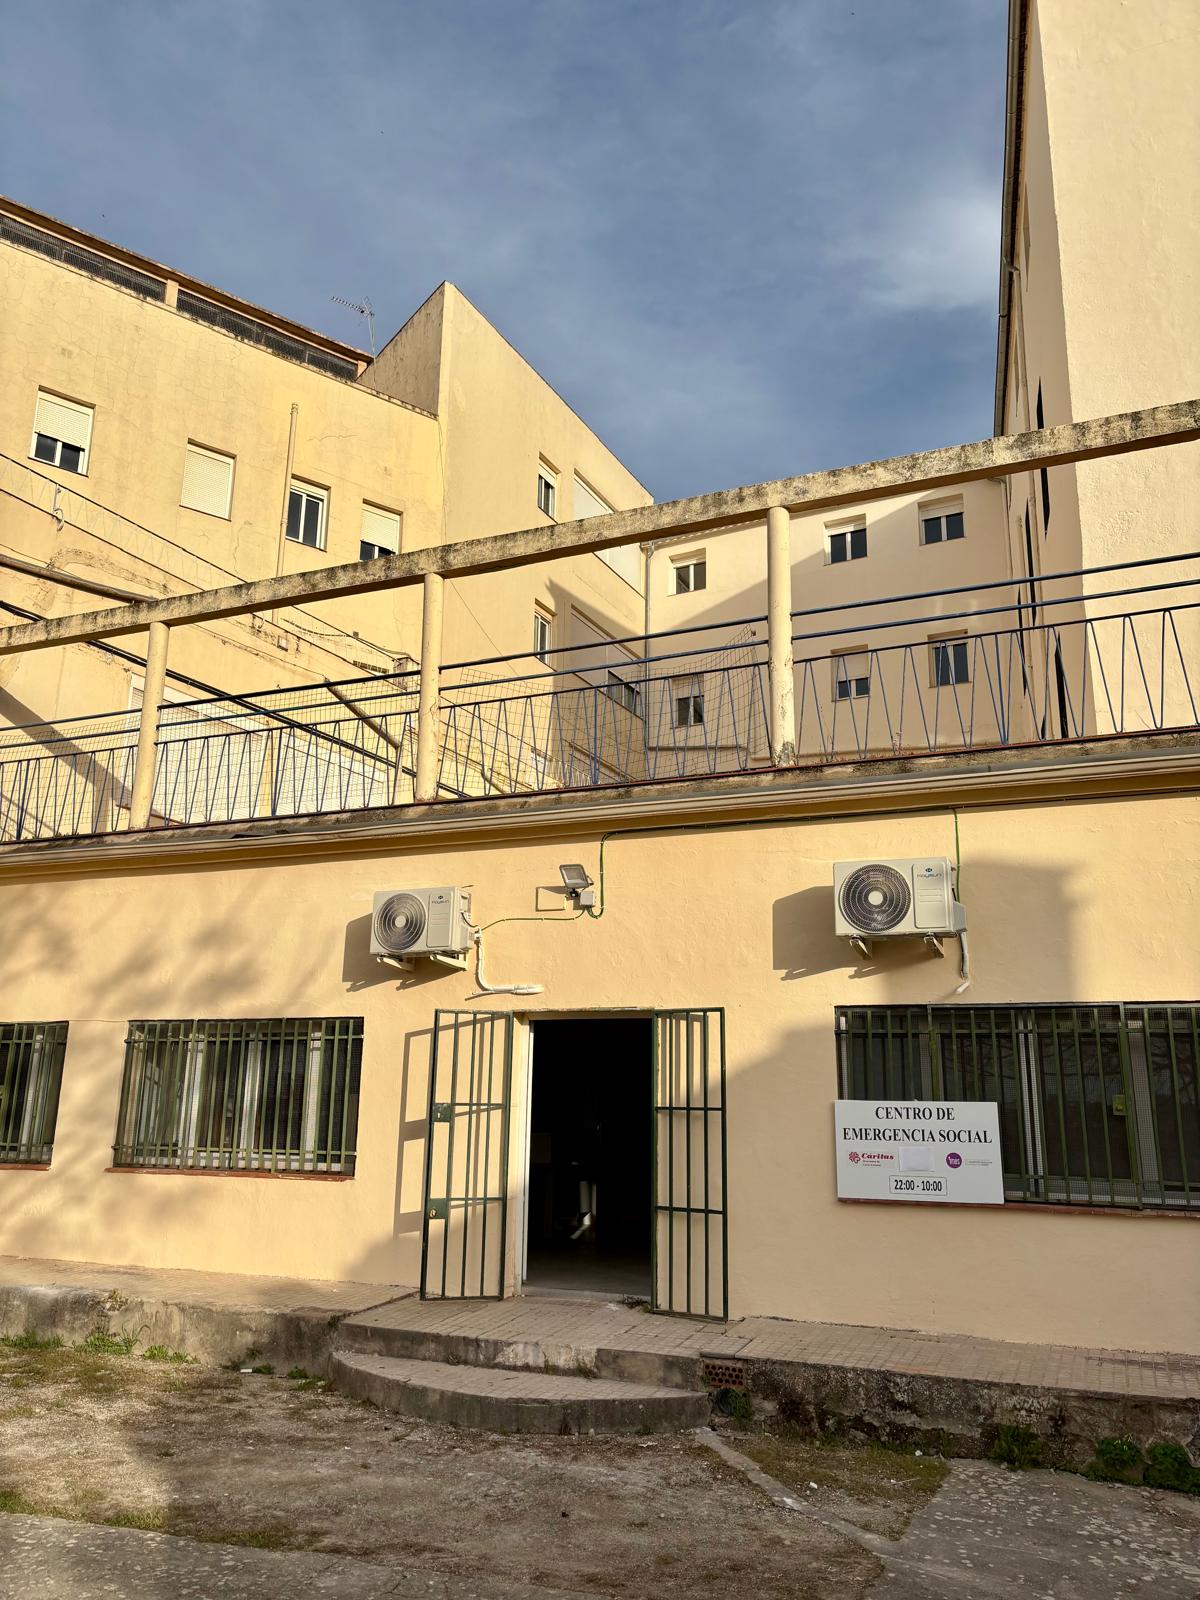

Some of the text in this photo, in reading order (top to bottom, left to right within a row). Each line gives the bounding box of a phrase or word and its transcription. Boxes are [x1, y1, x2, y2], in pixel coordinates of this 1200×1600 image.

[875, 1106, 955, 1121] CENTRO DE
[843, 1127, 993, 1144] EMERGENCIA SOCIAL
[894, 1179, 915, 1191] 22:00
[921, 1180, 942, 1192] 10:00
